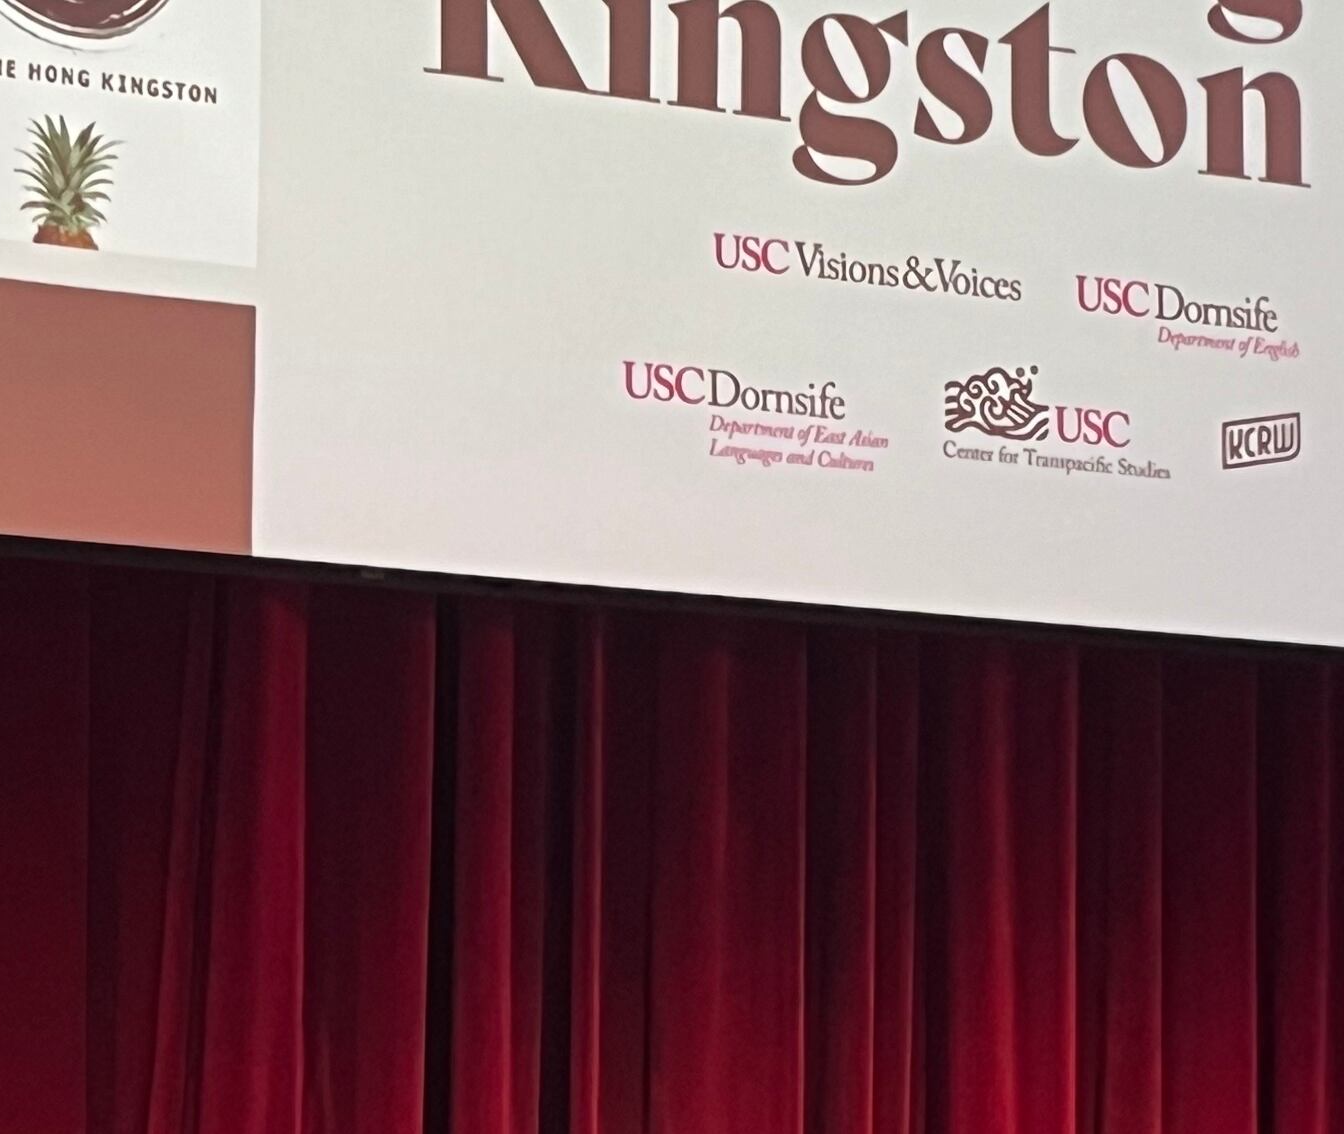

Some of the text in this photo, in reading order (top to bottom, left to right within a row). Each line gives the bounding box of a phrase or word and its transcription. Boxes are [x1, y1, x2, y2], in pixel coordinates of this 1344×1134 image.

[28, 62, 90, 88] HONG
[101, 72, 217, 104] KINGSTON
[714, 233, 790, 275] USC
[1076, 275, 1278, 333] USC Dornsife
[1158, 326, 1300, 361] Department of English
[622, 361, 846, 420] USC Dornsife
[709, 415, 888, 448] Department of East Asian
[1055, 406, 1131, 448] USC
[1229, 422, 1294, 460] KCRW
[709, 438, 874, 472] Languages and Cultures
[943, 440, 1171, 479] Center for Transpacific Studies
